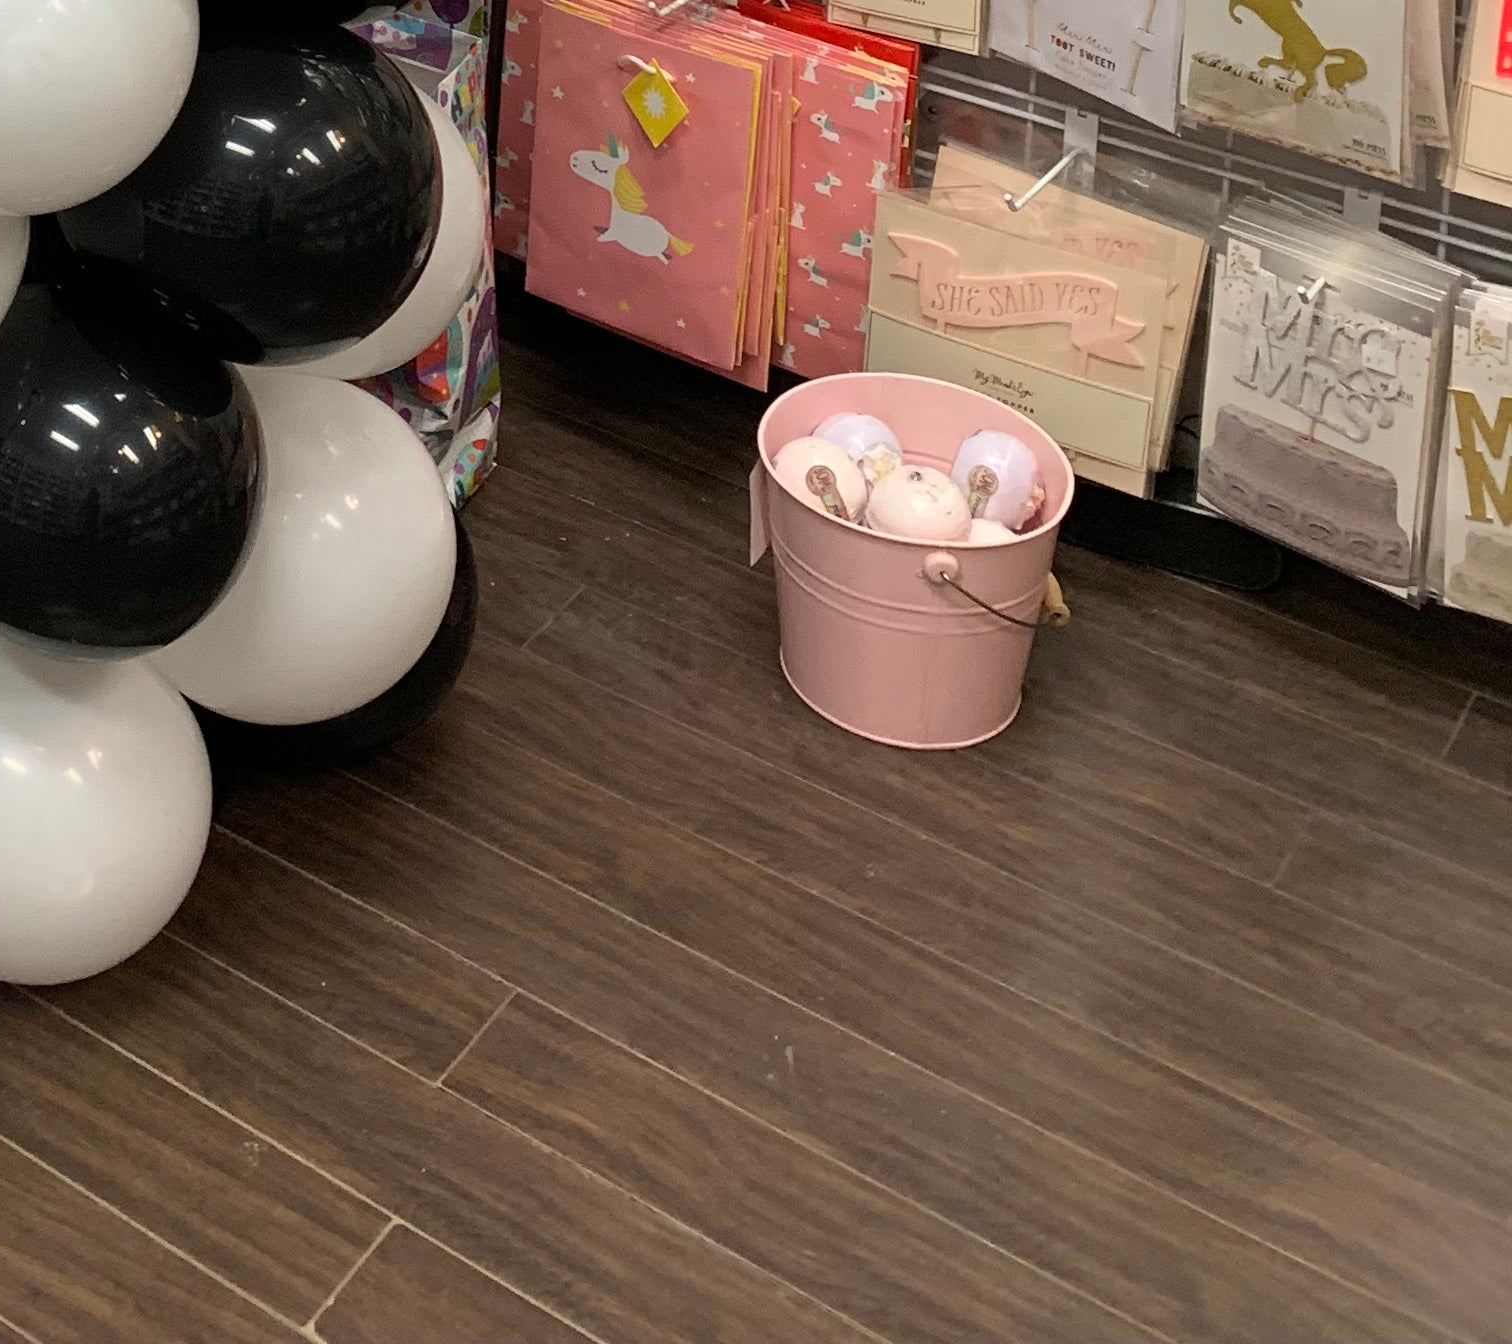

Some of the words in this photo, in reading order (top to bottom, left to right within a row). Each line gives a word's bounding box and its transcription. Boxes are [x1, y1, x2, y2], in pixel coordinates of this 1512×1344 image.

[1050, 33, 1075, 53] TOOT
[1079, 48, 1117, 73] SWEET!
[931, 282, 982, 317] SHE
[988, 282, 1046, 318] SAID
[1055, 282, 1102, 317] YES
